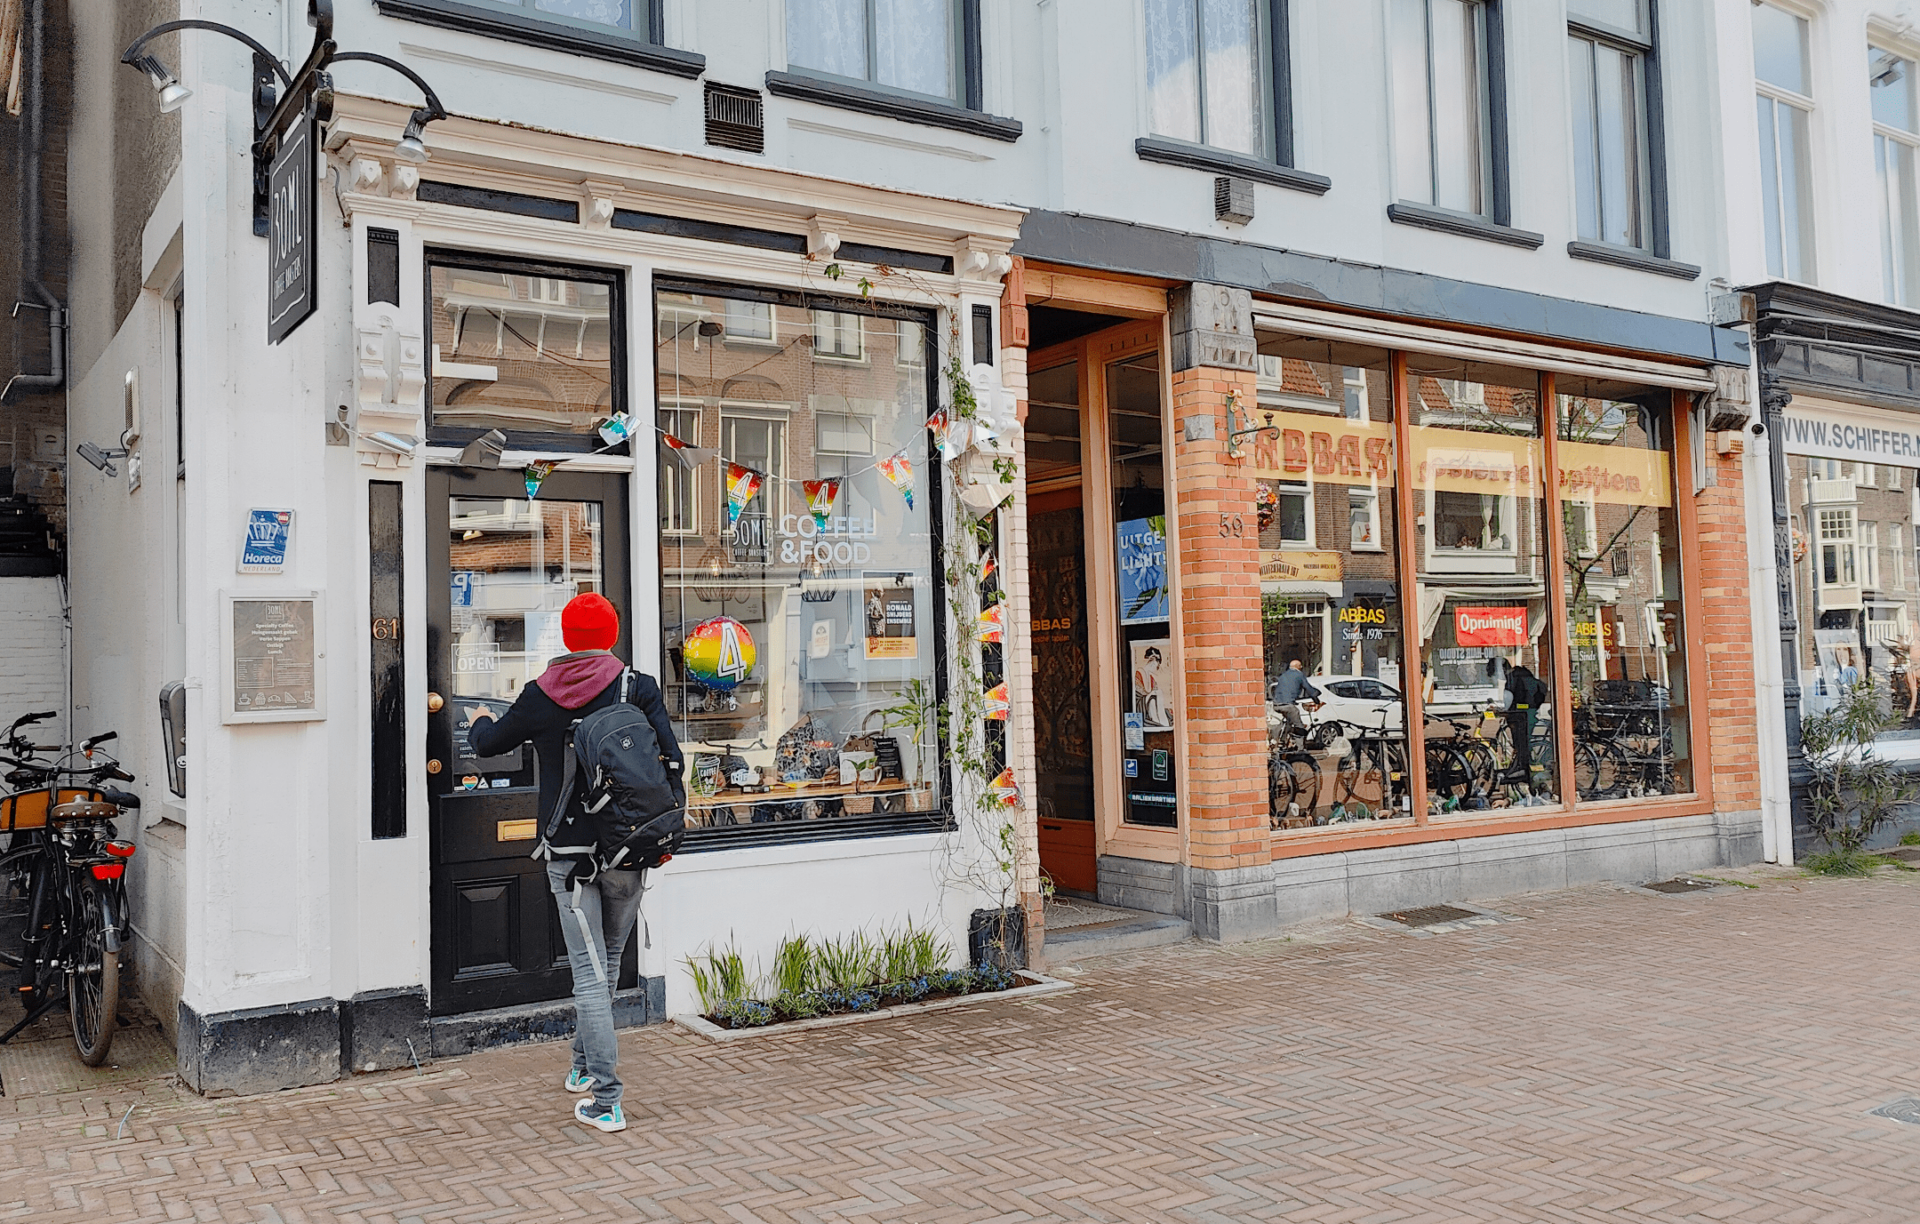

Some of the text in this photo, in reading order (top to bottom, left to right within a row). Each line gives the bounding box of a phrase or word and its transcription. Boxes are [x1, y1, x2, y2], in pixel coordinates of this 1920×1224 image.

[274, 164, 302, 269] 30ML
[892, 460, 914, 491] 4
[1556, 465, 1642, 496] apijten
[729, 472, 754, 504] 4
[812, 482, 829, 516] 4
[1219, 513, 1243, 538] 59
[245, 553, 282, 563] Horeca
[1031, 617, 1071, 631] BBAS
[1338, 608, 1385, 624] ABBAS
[1460, 614, 1523, 634] Opruiming
[373, 618, 398, 640] 61
[1342, 628, 1383, 640] Sinds 1976
[1575, 622, 1612, 636] ABBS
[717, 622, 747, 682] 4
[1580, 650, 1596, 661] Sinds
[457, 657, 495, 671] OPEN
